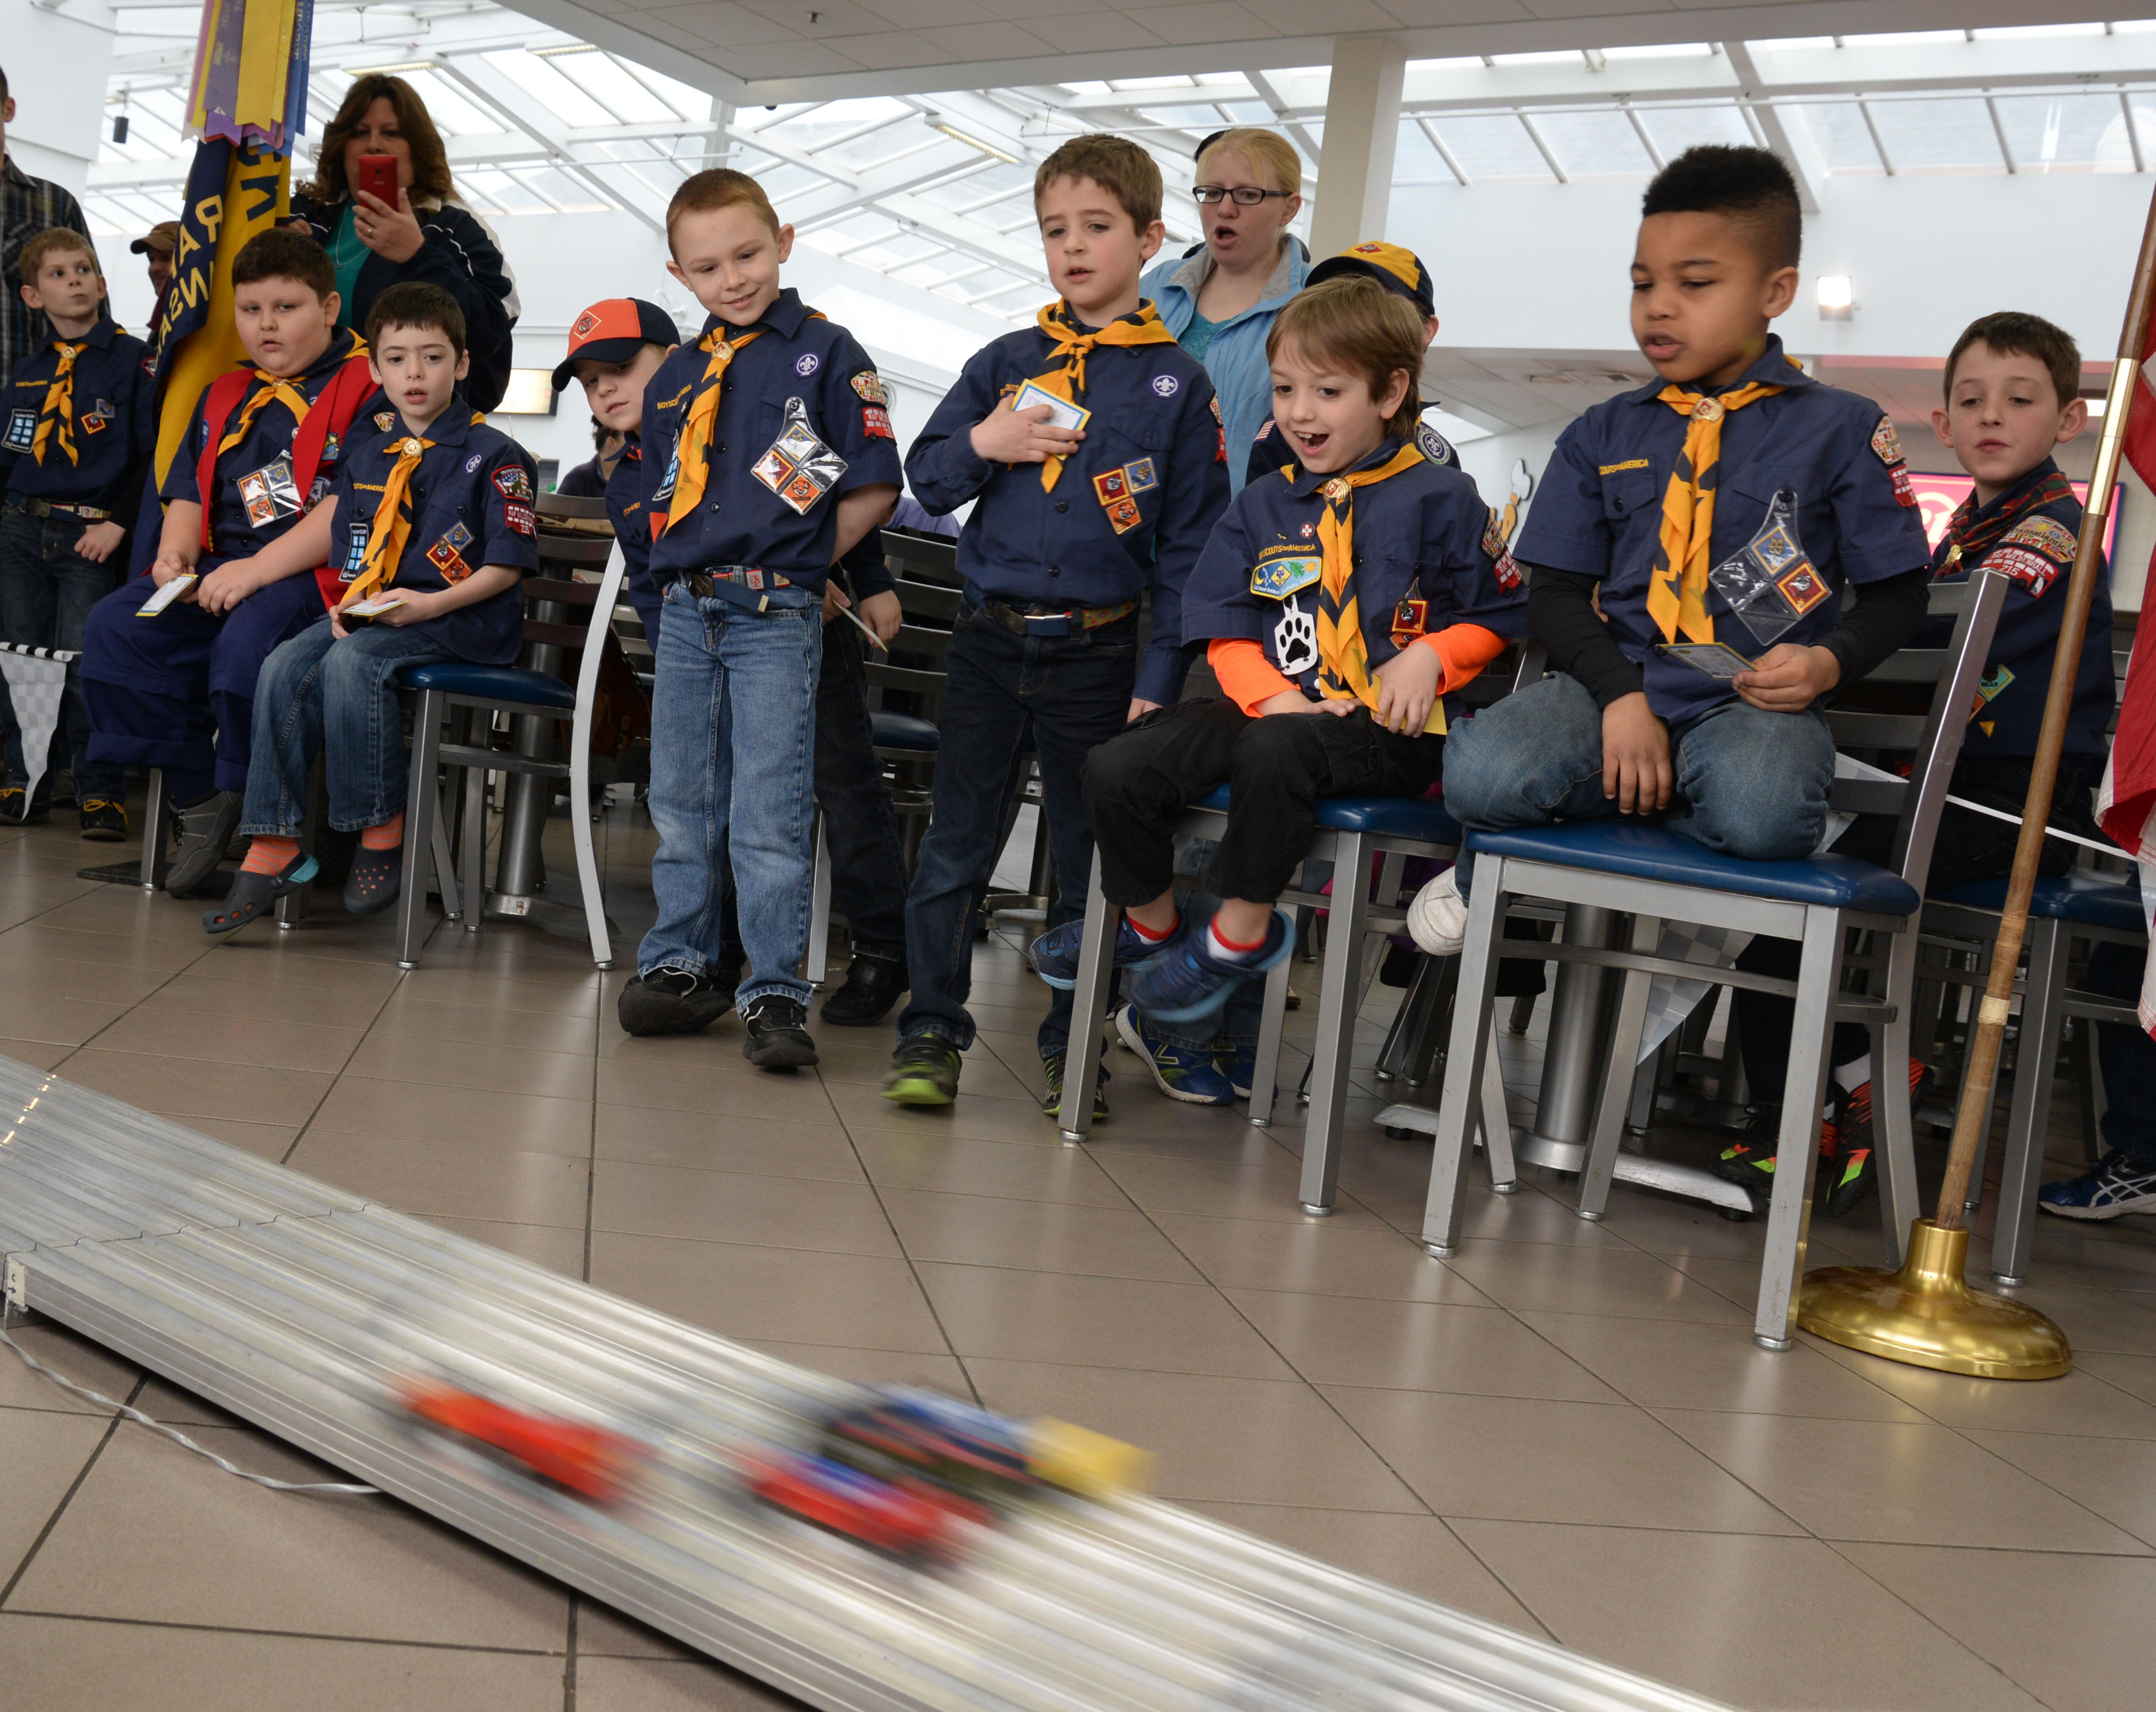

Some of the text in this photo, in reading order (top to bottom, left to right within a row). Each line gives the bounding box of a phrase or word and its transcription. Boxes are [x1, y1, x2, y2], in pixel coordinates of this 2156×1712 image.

[1287, 543, 1316, 552] AMERICA
[2010, 527, 2066, 551] Transatlantic
[1991, 549, 2046, 577] RAF MILDENHALL
[1999, 564, 2021, 576] 215
